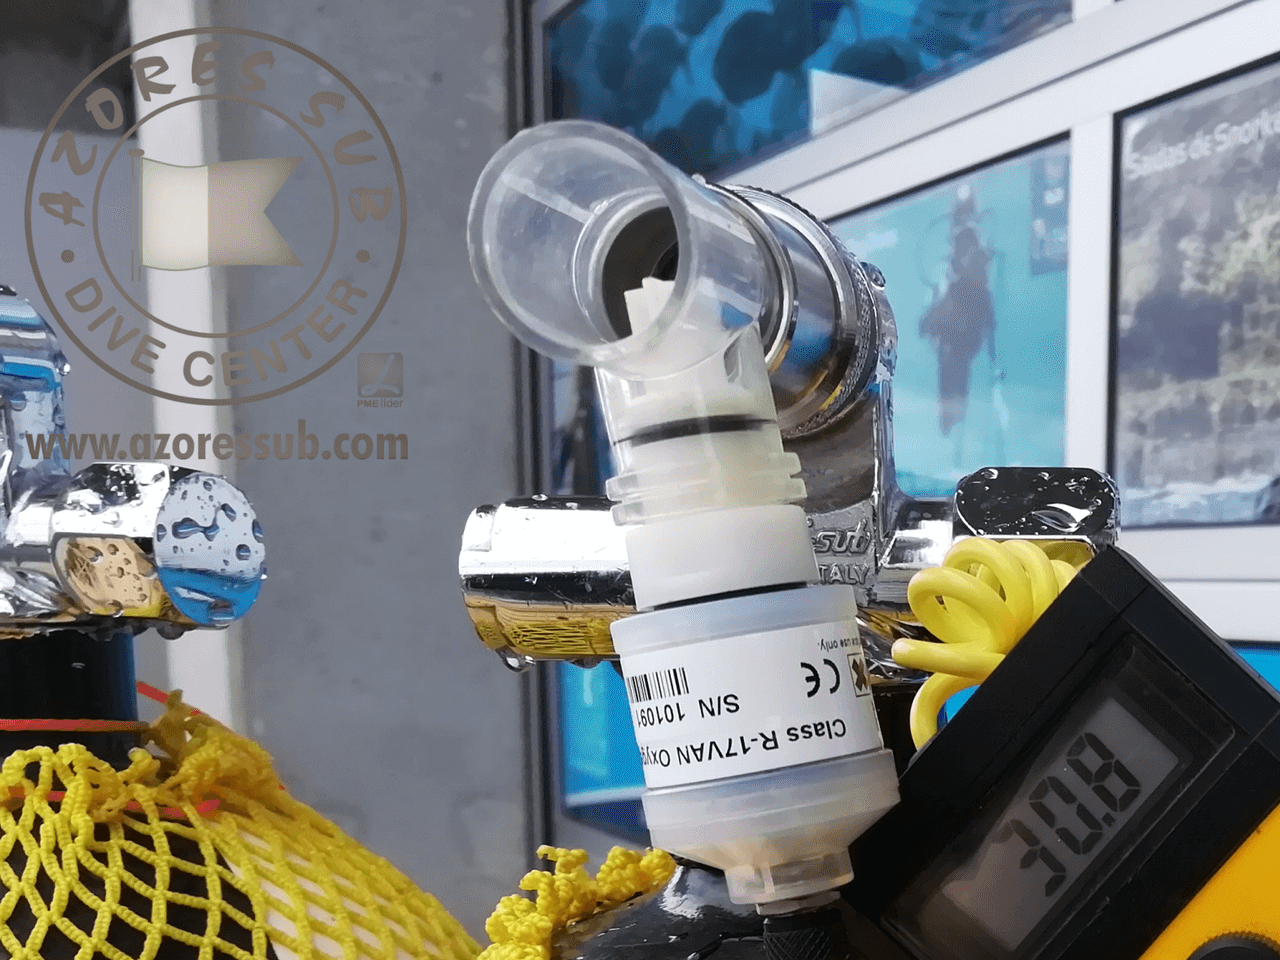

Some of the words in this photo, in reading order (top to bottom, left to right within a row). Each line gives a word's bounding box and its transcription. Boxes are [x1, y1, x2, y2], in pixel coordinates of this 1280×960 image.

[818, 562, 869, 584] TALY
[698, 693, 741, 719] S/N
[786, 718, 847, 743] Class
[677, 729, 779, 766] R-17VAN
[992, 732, 1141, 897] 30.8
